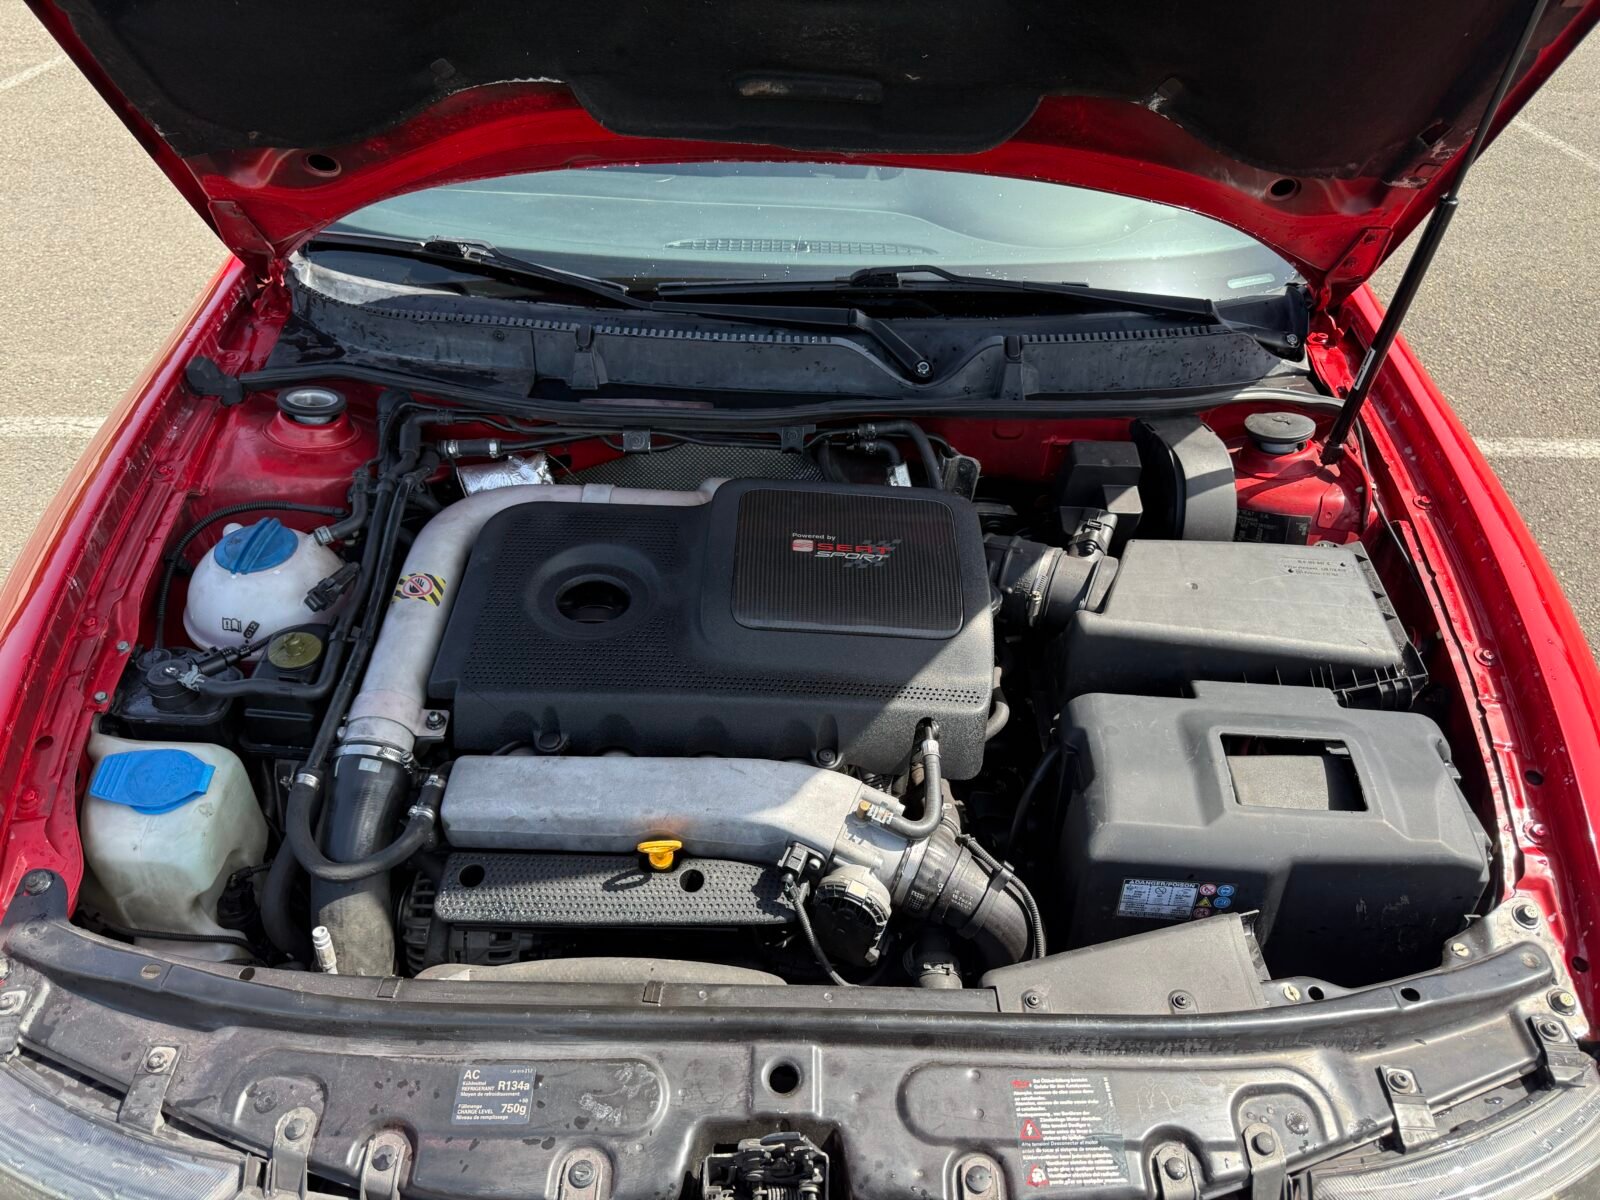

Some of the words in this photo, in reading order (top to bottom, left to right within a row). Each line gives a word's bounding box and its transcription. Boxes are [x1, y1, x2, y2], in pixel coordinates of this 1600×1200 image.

[817, 543, 891, 554] SEAT
[815, 551, 890, 562] SPORT
[464, 1070, 480, 1079] AC
[498, 1081, 530, 1091] R134a
[500, 1104, 526, 1115] 750g
